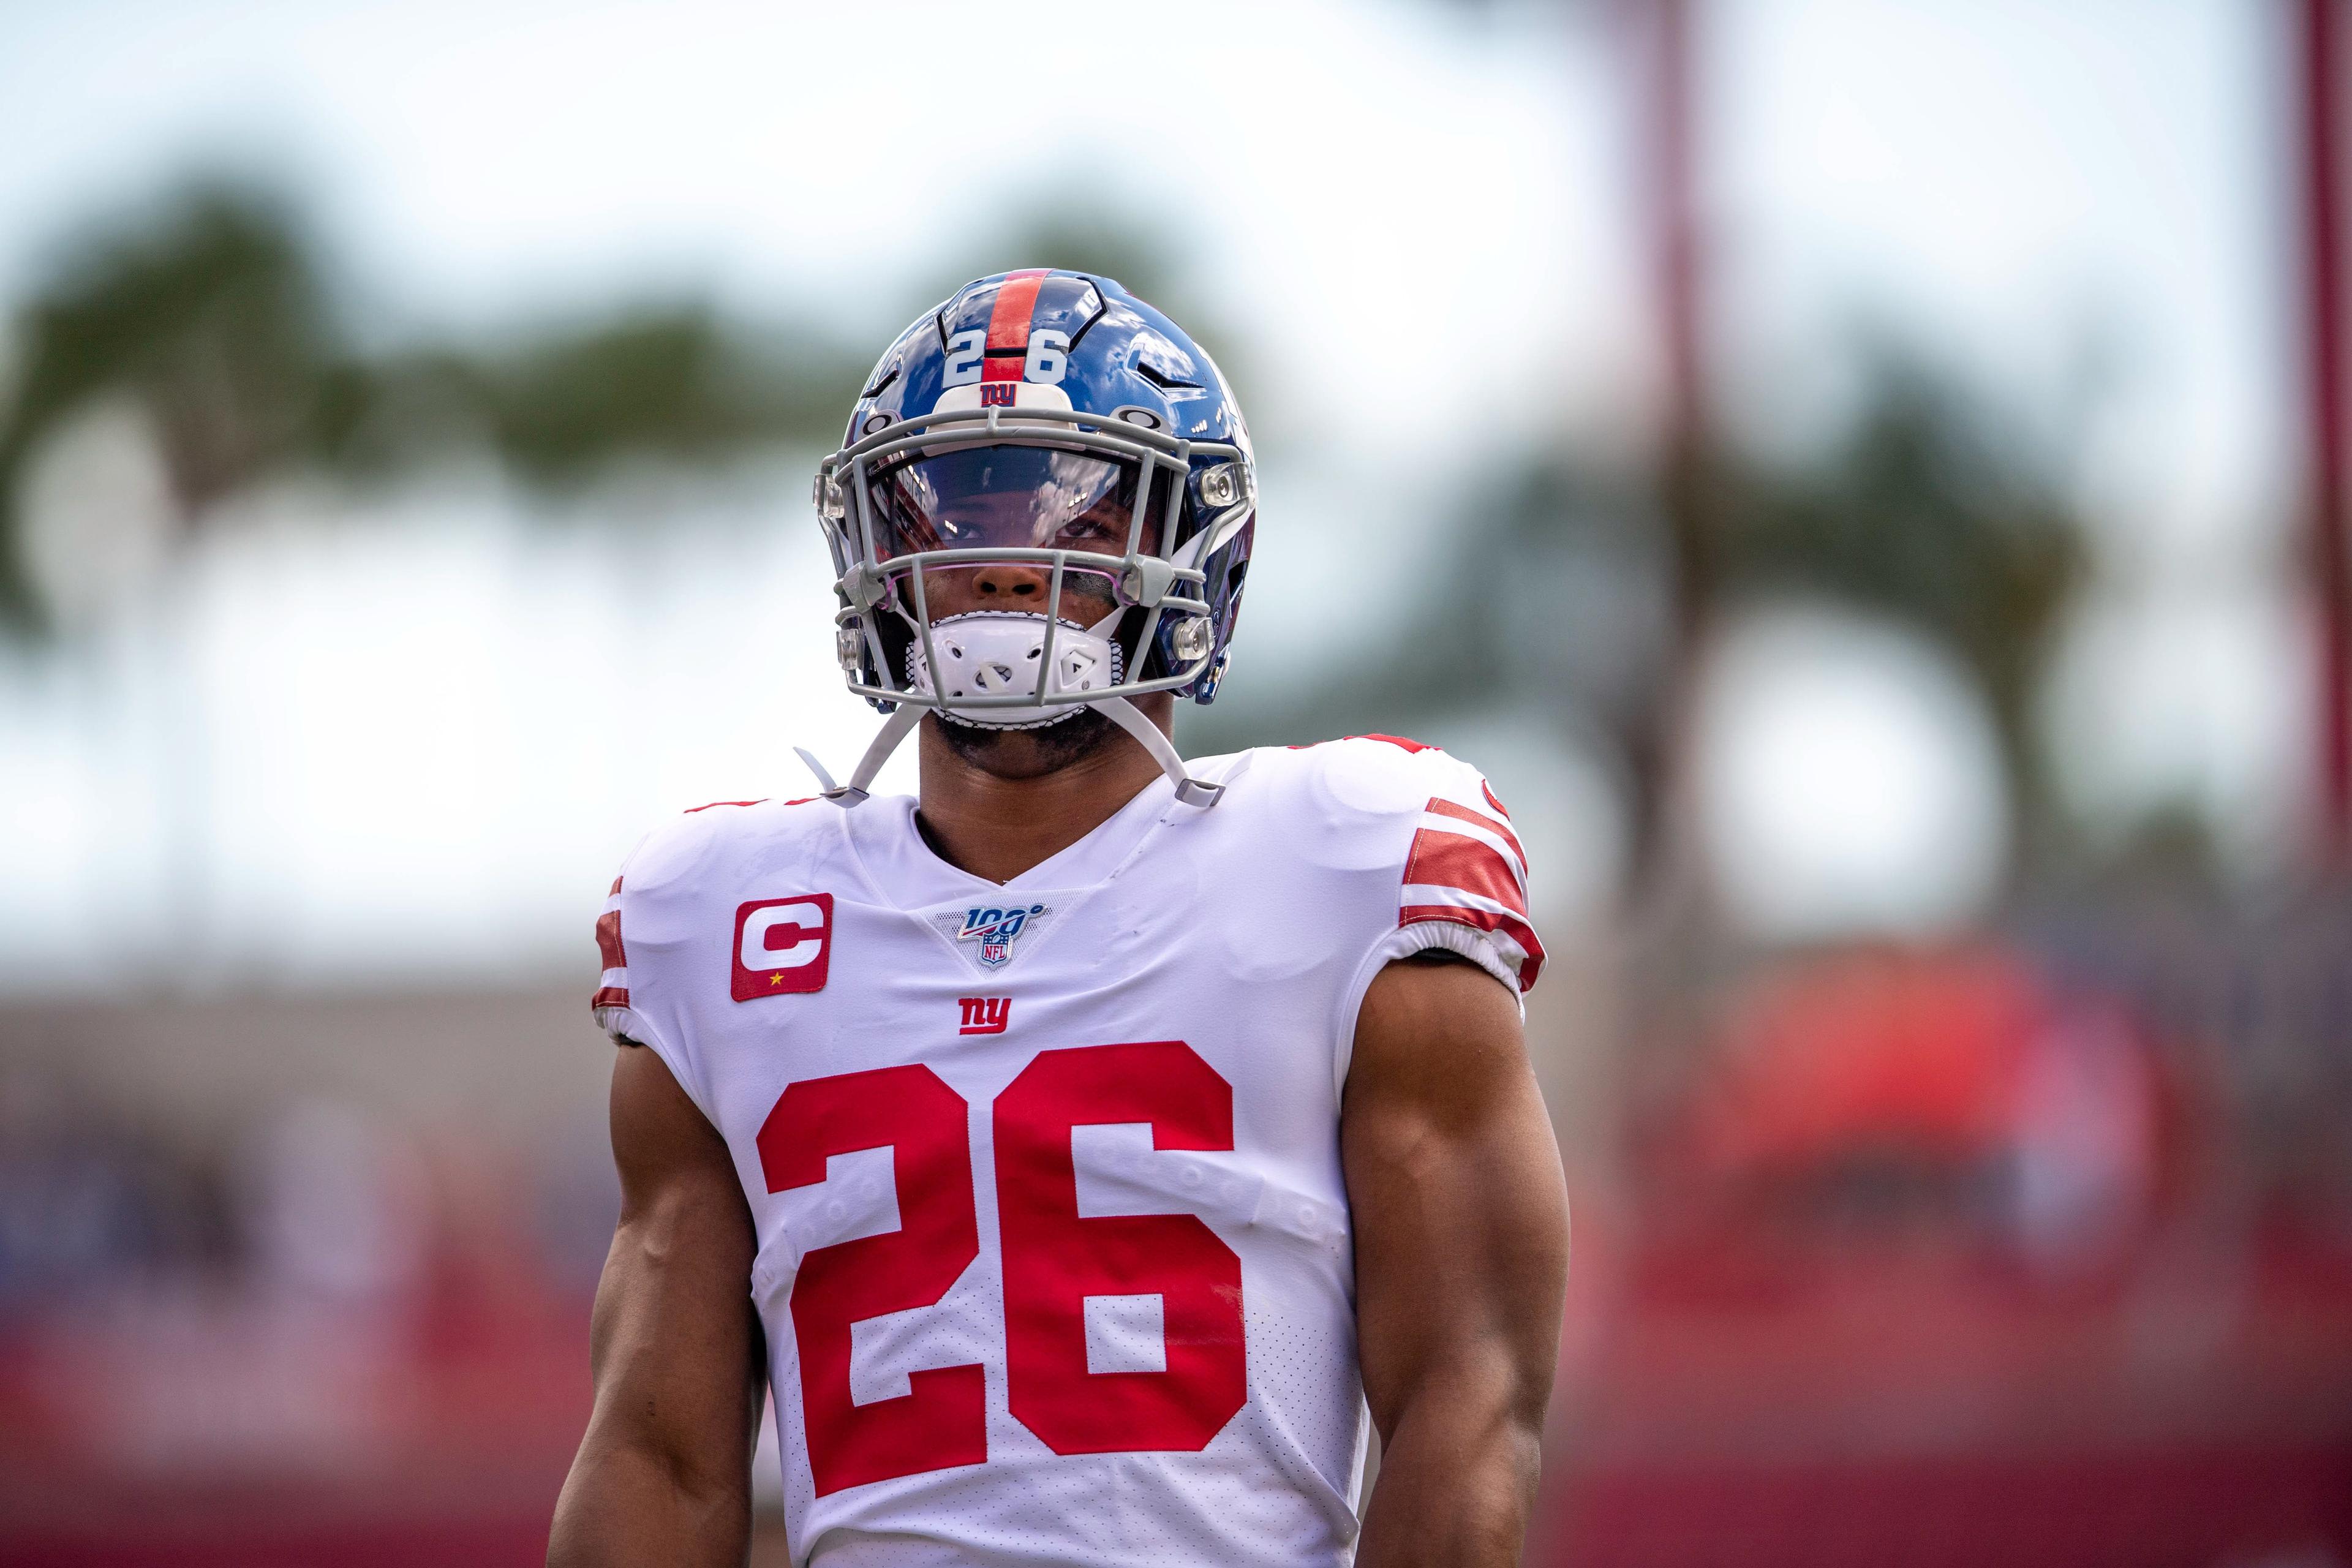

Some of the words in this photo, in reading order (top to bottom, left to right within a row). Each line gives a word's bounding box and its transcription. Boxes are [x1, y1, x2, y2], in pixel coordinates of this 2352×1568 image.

[741, 902, 824, 972] C
[984, 945, 1005, 960] NFL
[756, 1040, 1247, 1499] 26
